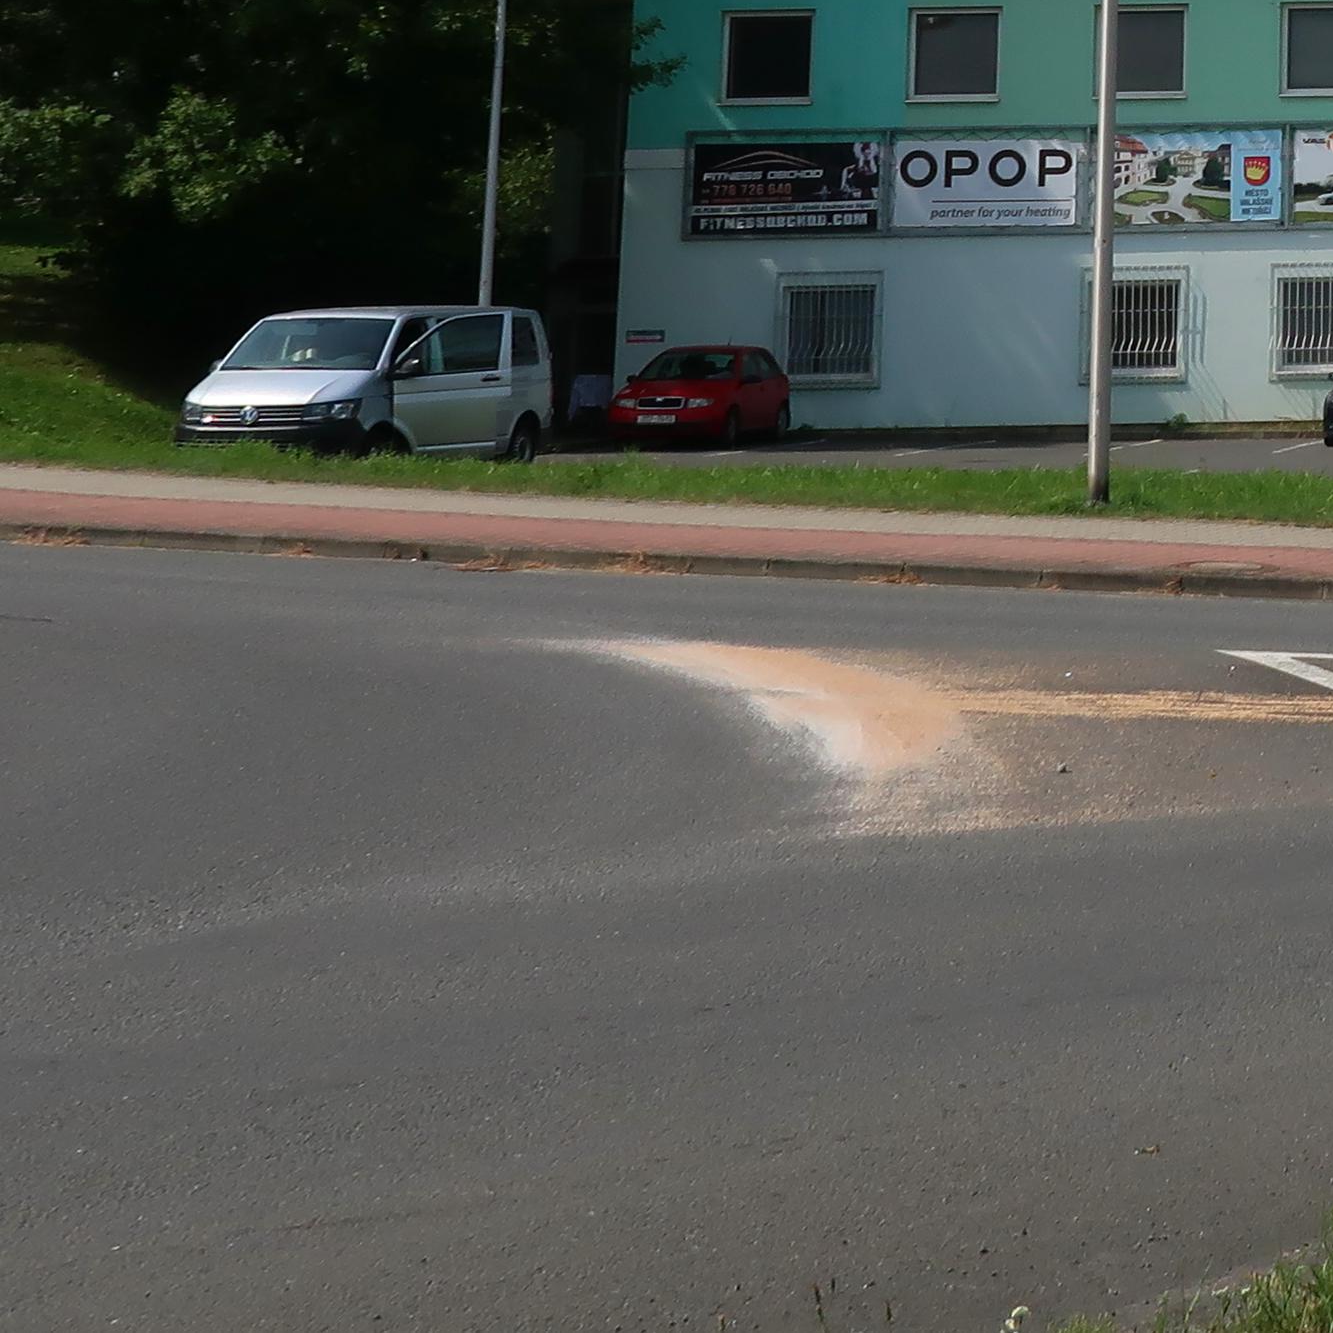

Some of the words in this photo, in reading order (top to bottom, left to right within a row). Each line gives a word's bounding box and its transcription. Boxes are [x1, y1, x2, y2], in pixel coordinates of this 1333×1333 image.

[703, 170, 763, 182] FITNESS
[900, 149, 1073, 188] OPOP
[930, 208, 975, 220] partner
[977, 206, 995, 218] for
[995, 207, 1024, 219] your
[1025, 205, 1071, 219] heating
